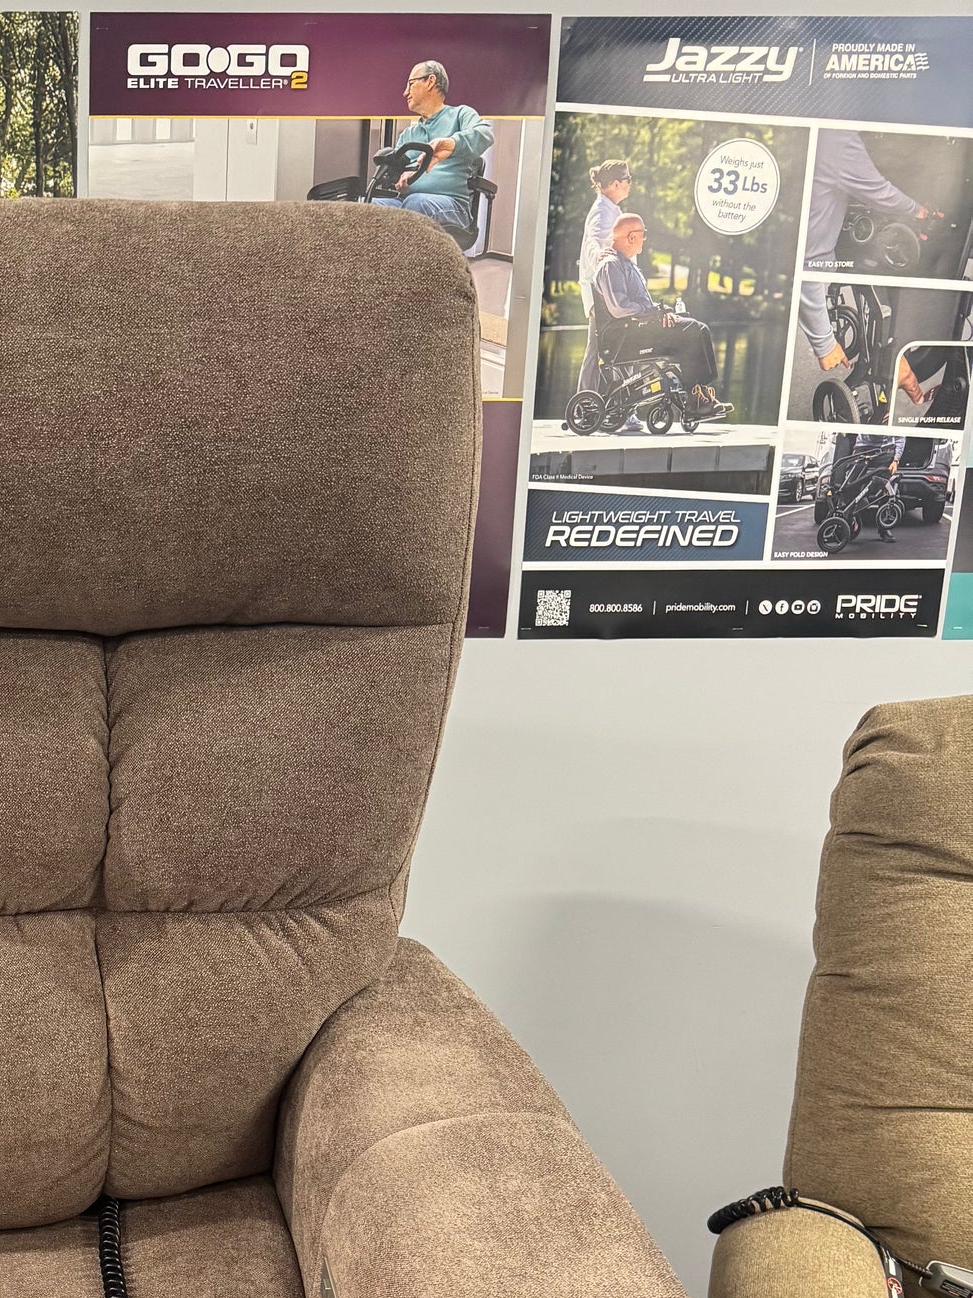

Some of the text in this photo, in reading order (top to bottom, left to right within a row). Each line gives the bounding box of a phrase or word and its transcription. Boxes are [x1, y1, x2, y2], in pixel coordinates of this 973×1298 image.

[832, 43, 916, 52] PROUDLY MADE IN
[645, 37, 799, 82] Jazzy
[825, 54, 917, 71] AMERICA
[127, 77, 178, 89] ELITE
[290, 71, 308, 89] 2
[671, 73, 763, 84] ULTRA LIGHT
[720, 155, 764, 170] Weighs just
[707, 167, 768, 196] 33 Lbs
[712, 198, 757, 212] without the
[717, 209, 747, 224] battery
[808, 260, 854, 268] EASY TO STORE
[551, 510, 741, 523] LIGHTWEIGHT TRAVEL
[545, 524, 739, 547] REDEFINED
[589, 602, 736, 614] 800.800.8586 pridemobility.com
[835, 594, 918, 613] PRIDE
